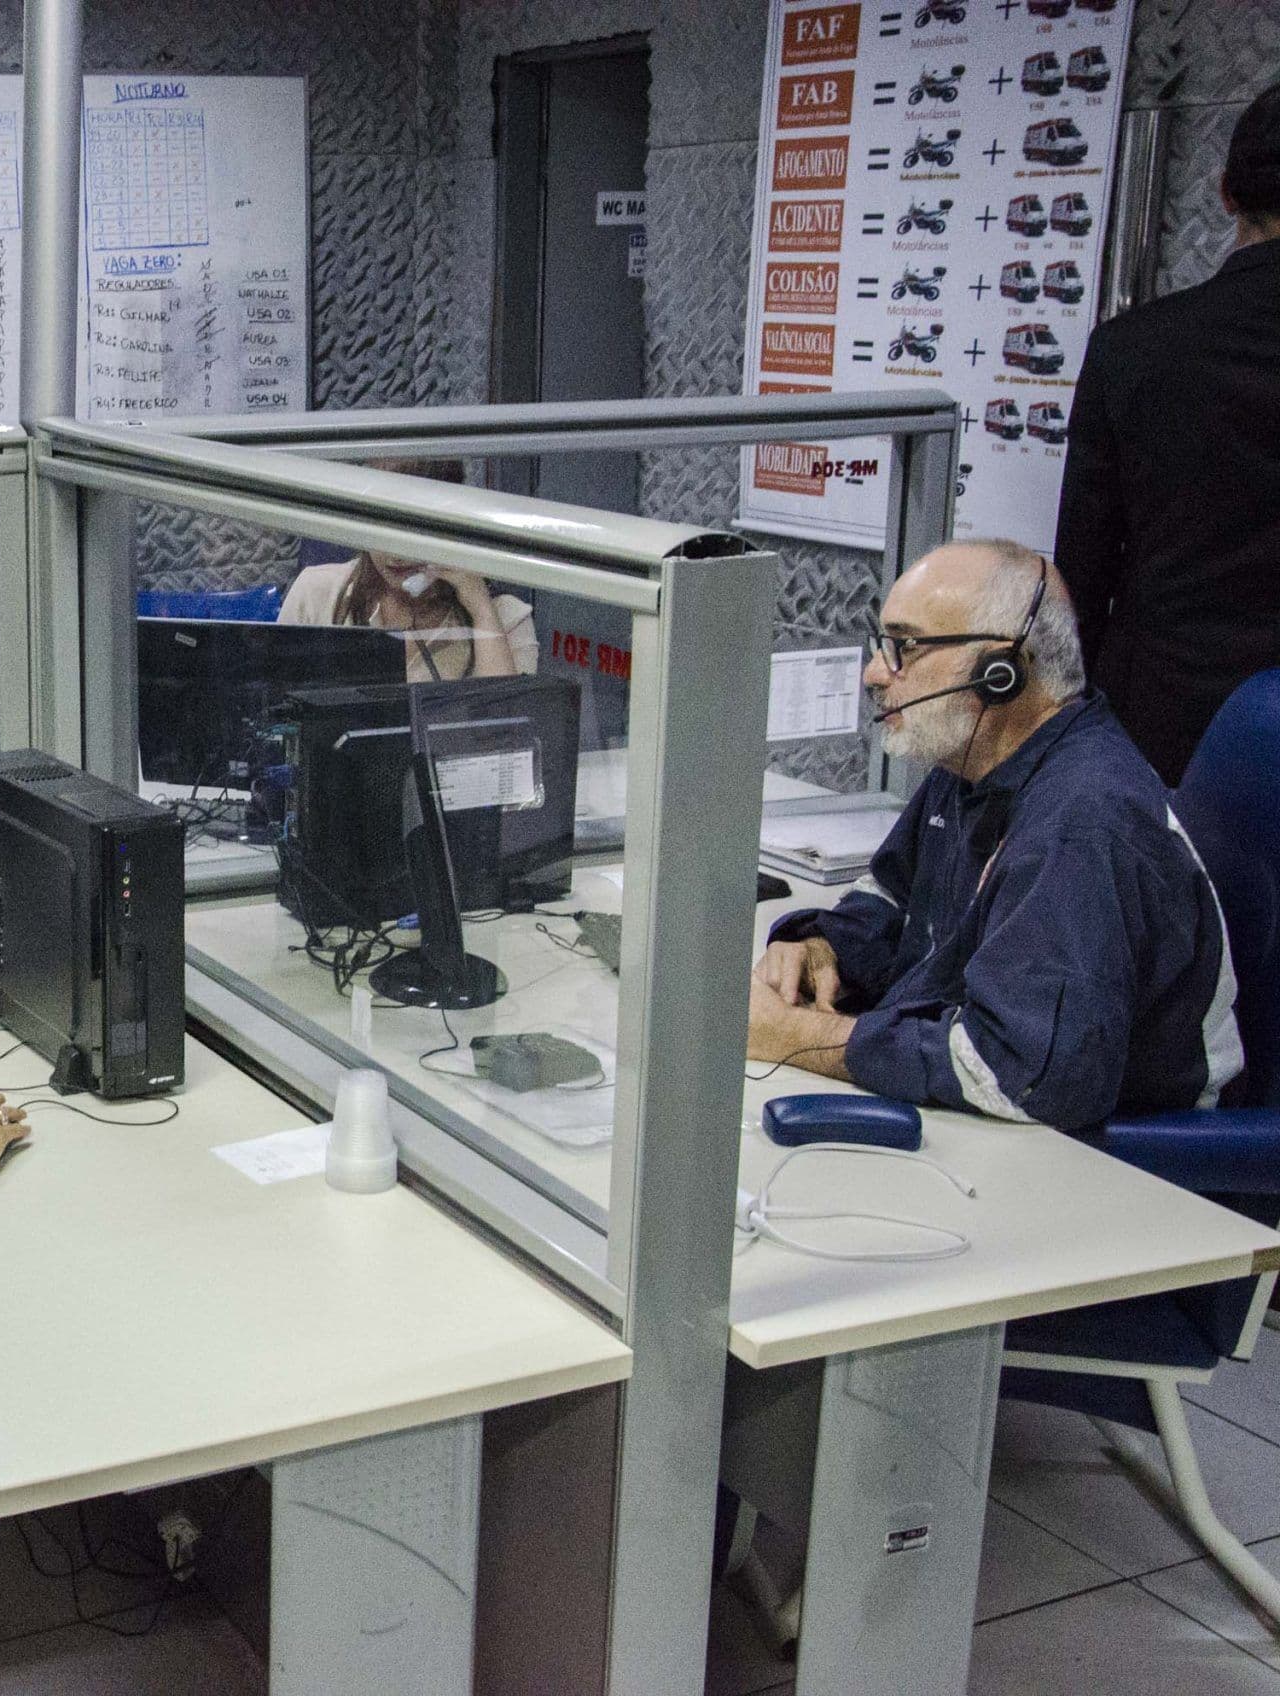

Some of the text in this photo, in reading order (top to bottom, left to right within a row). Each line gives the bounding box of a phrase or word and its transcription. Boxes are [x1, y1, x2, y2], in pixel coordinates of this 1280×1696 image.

[796, 14, 845, 42] FAF
[792, 81, 838, 106] FAB
[777, 148, 845, 178] AFOGAMENTO
[602, 201, 622, 216] WC
[772, 204, 840, 232] ACIDENTE
[104, 256, 138, 273] VAGA
[96, 278, 175, 291] REGULADORES
[768, 265, 836, 293] COLISÃO
